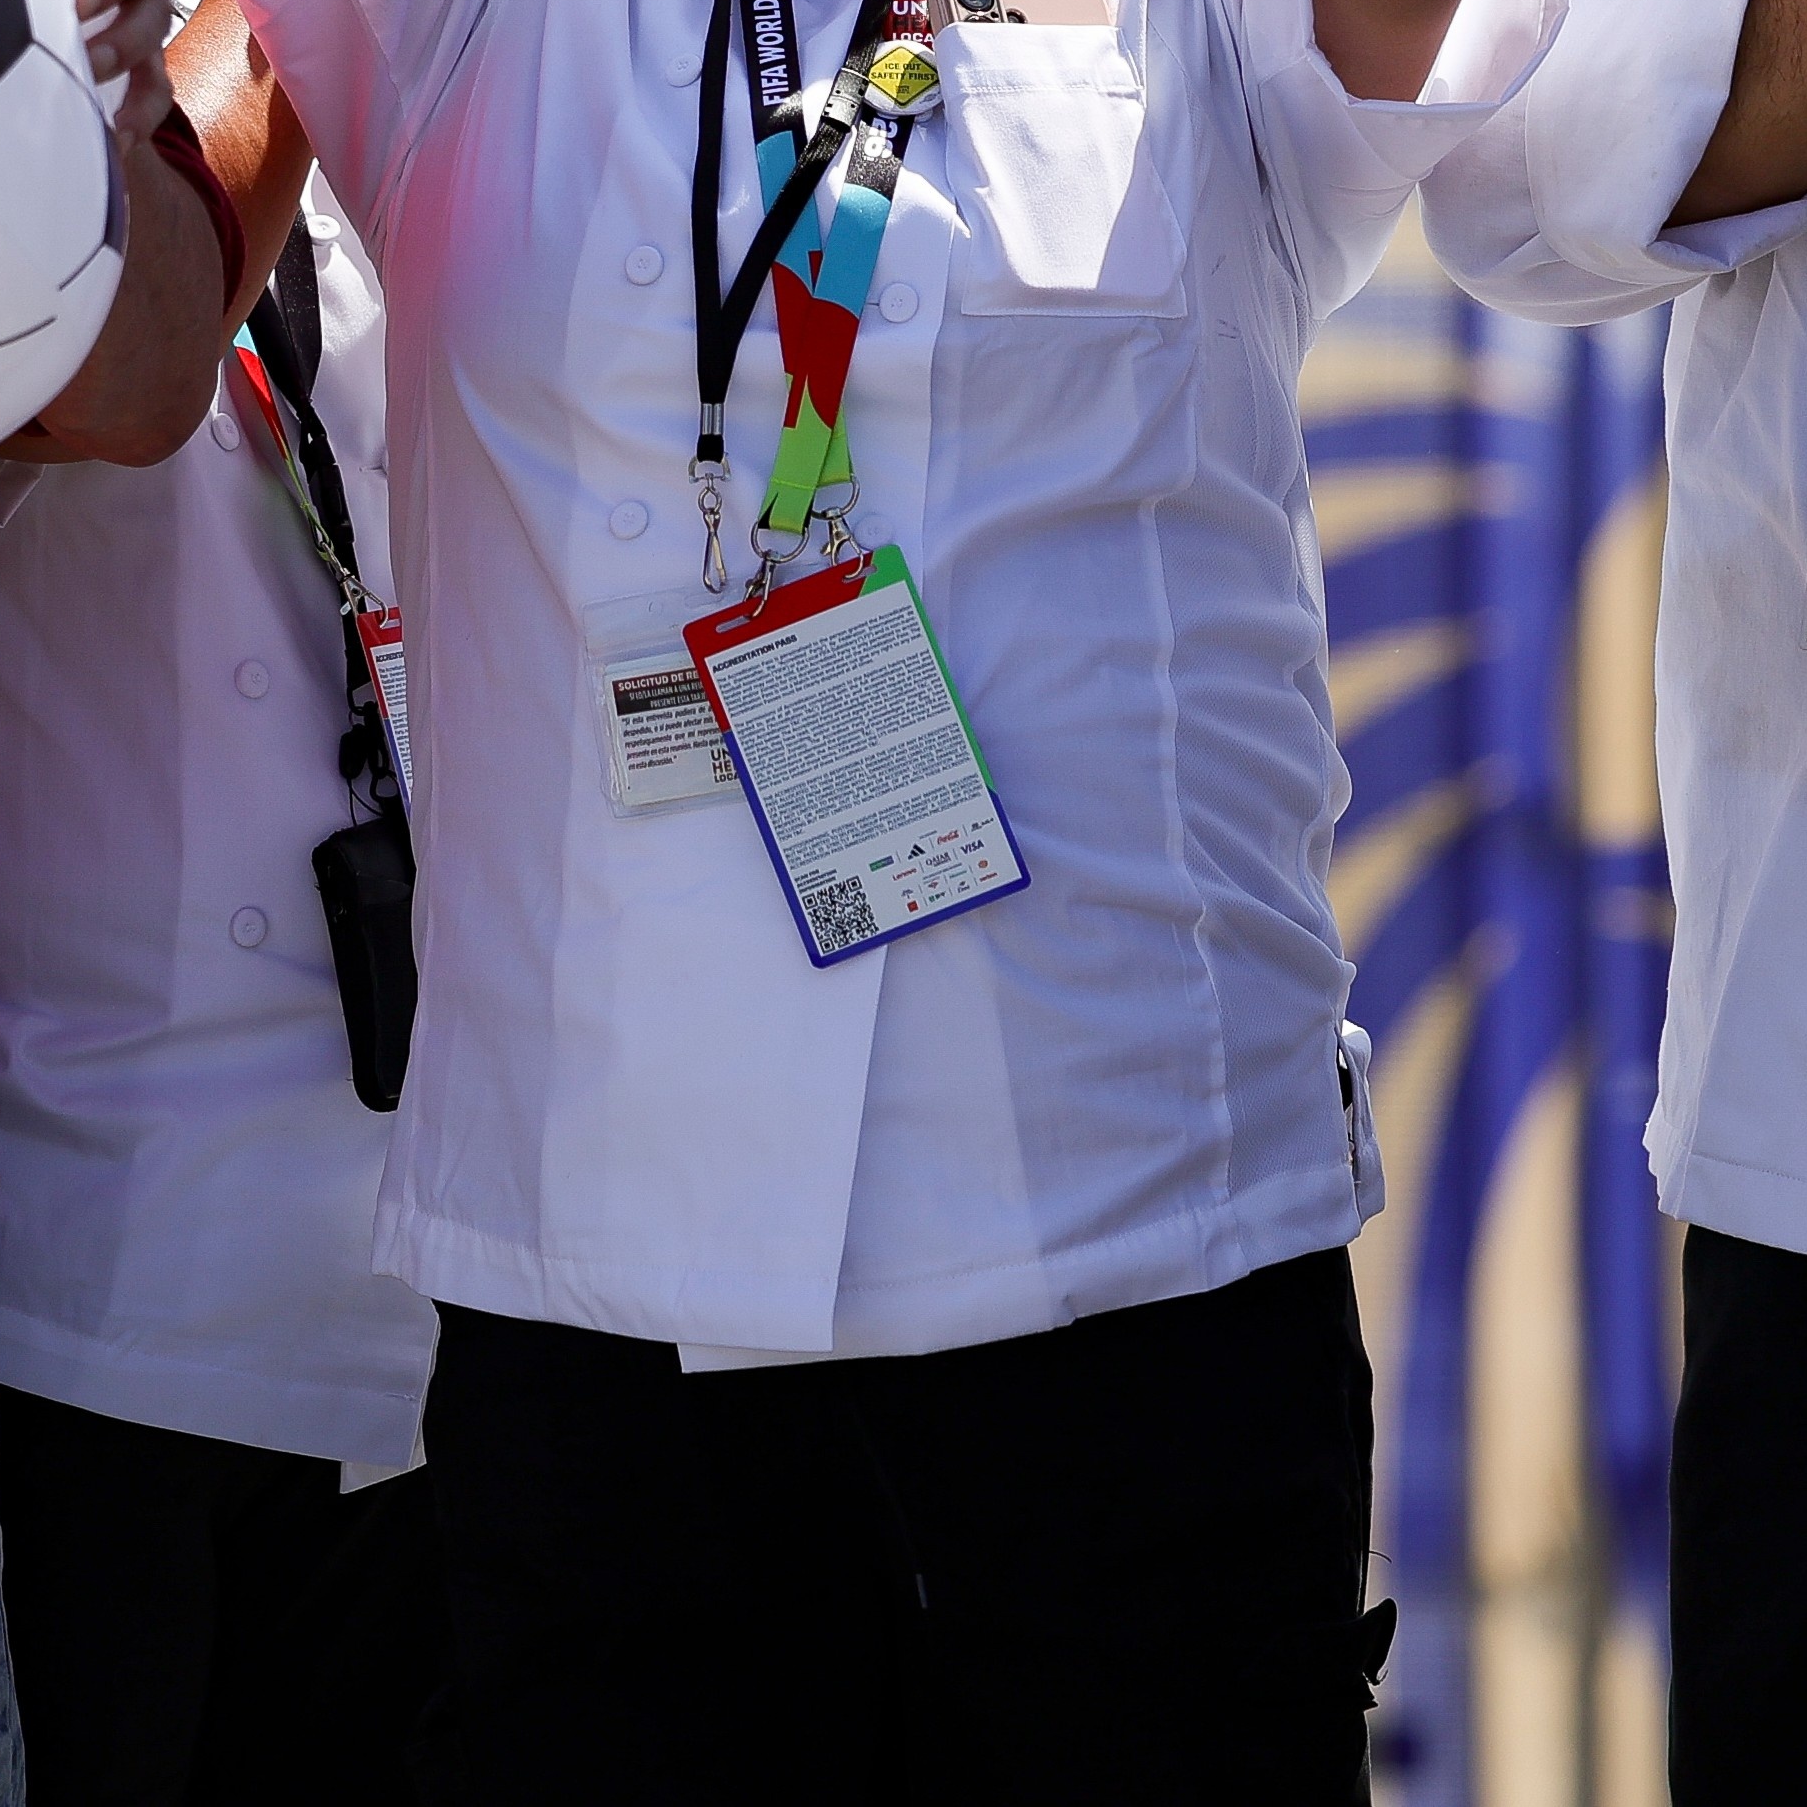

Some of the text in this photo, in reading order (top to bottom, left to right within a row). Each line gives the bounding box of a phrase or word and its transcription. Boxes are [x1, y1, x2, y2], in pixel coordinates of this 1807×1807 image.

[760, 64, 790, 107] FIFA
[870, 72, 936, 81] SAFETY FIRST
[711, 642, 774, 673] ACCREDITATION
[774, 633, 797, 648] PASS
[618, 675, 668, 691] SOLICITUD
[670, 672, 683, 682] DE
[892, 866, 917, 881] Lenovo
[925, 850, 949, 866] QATAR
[960, 838, 984, 855] VISA
